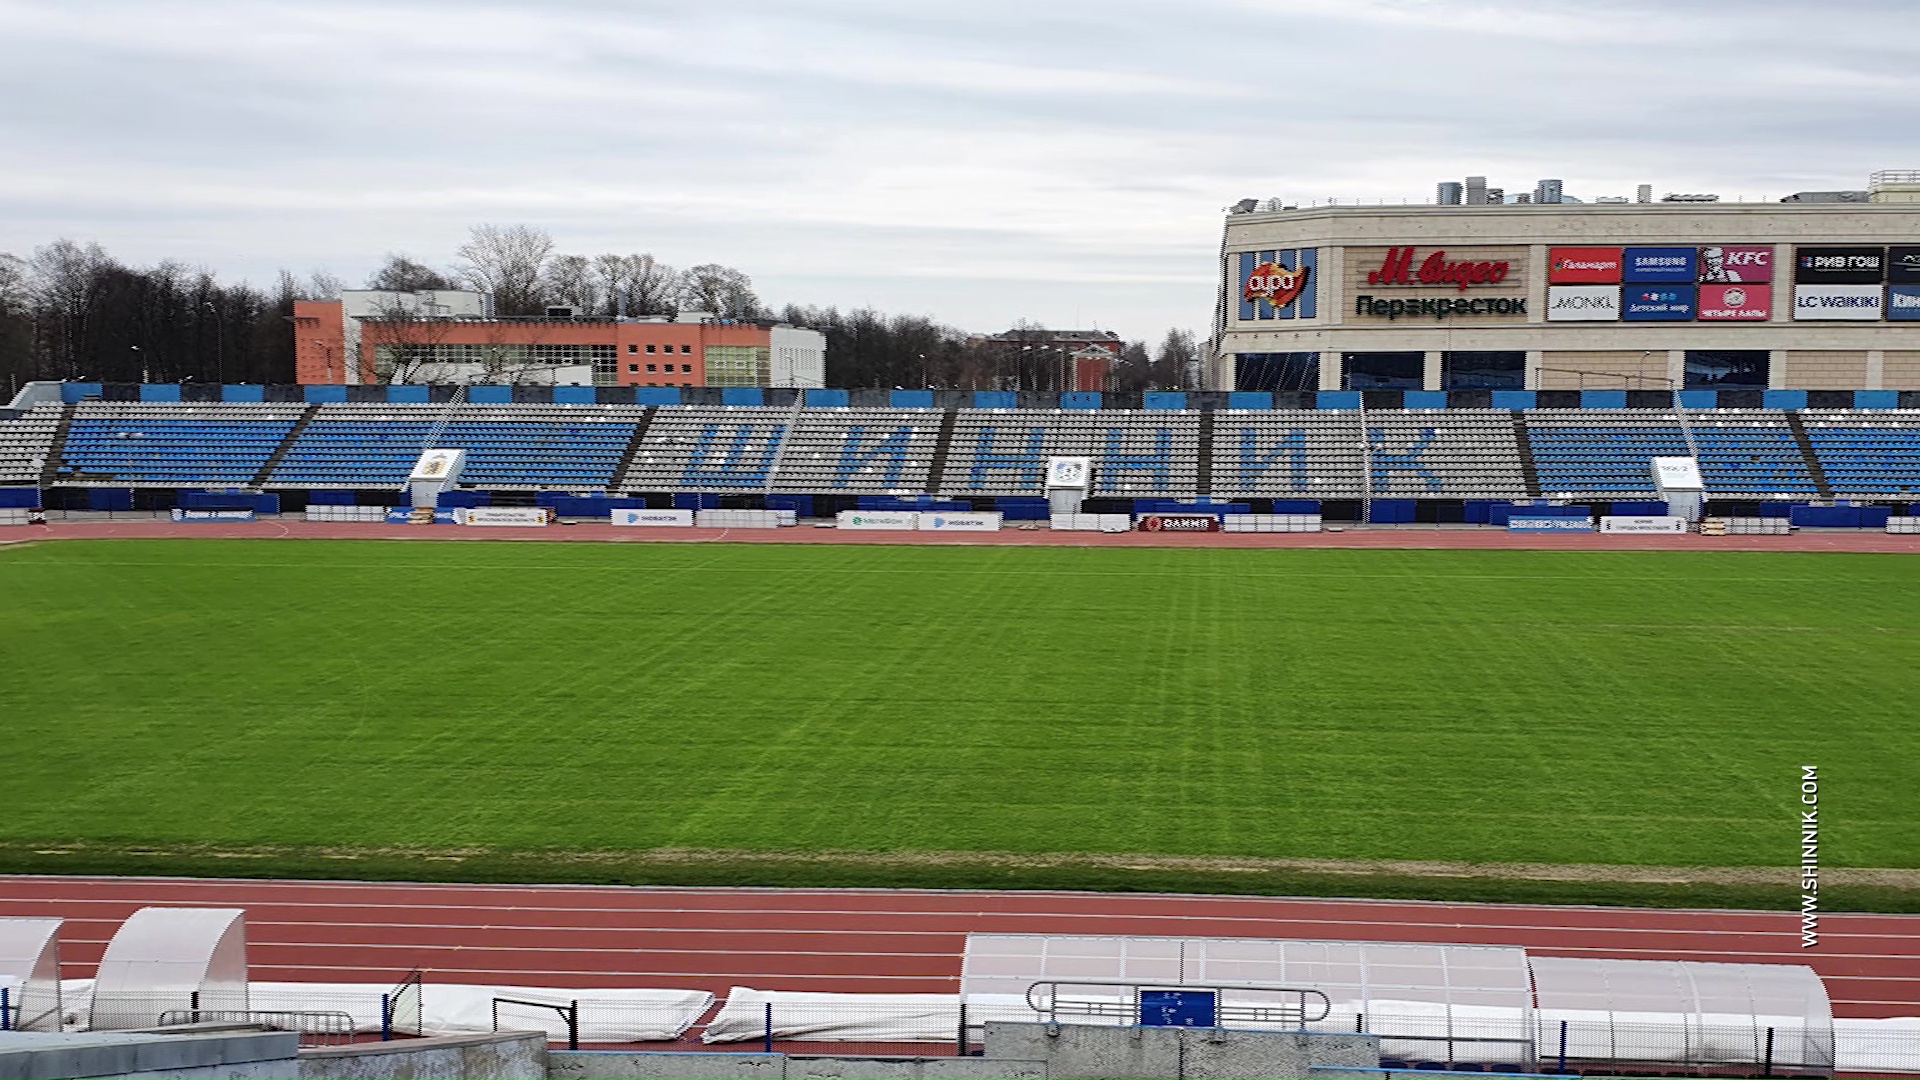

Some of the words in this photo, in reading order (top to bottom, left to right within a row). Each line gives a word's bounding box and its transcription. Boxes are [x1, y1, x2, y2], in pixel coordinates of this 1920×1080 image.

[1562, 258, 1617, 272] Галамарт
[1634, 256, 1687, 267] SAMSUNG
[1727, 251, 1769, 266] KFC
[1814, 255, 1847, 268] РИВ
[1848, 255, 1880, 268] ГОШ
[1628, 302, 1669, 313] Детский
[1670, 303, 1690, 314] мир
[1797, 295, 1818, 308] LC
[1702, 309, 1737, 318] ЧЕТЫРЕ
[1738, 309, 1767, 318] ЛАПЫ
